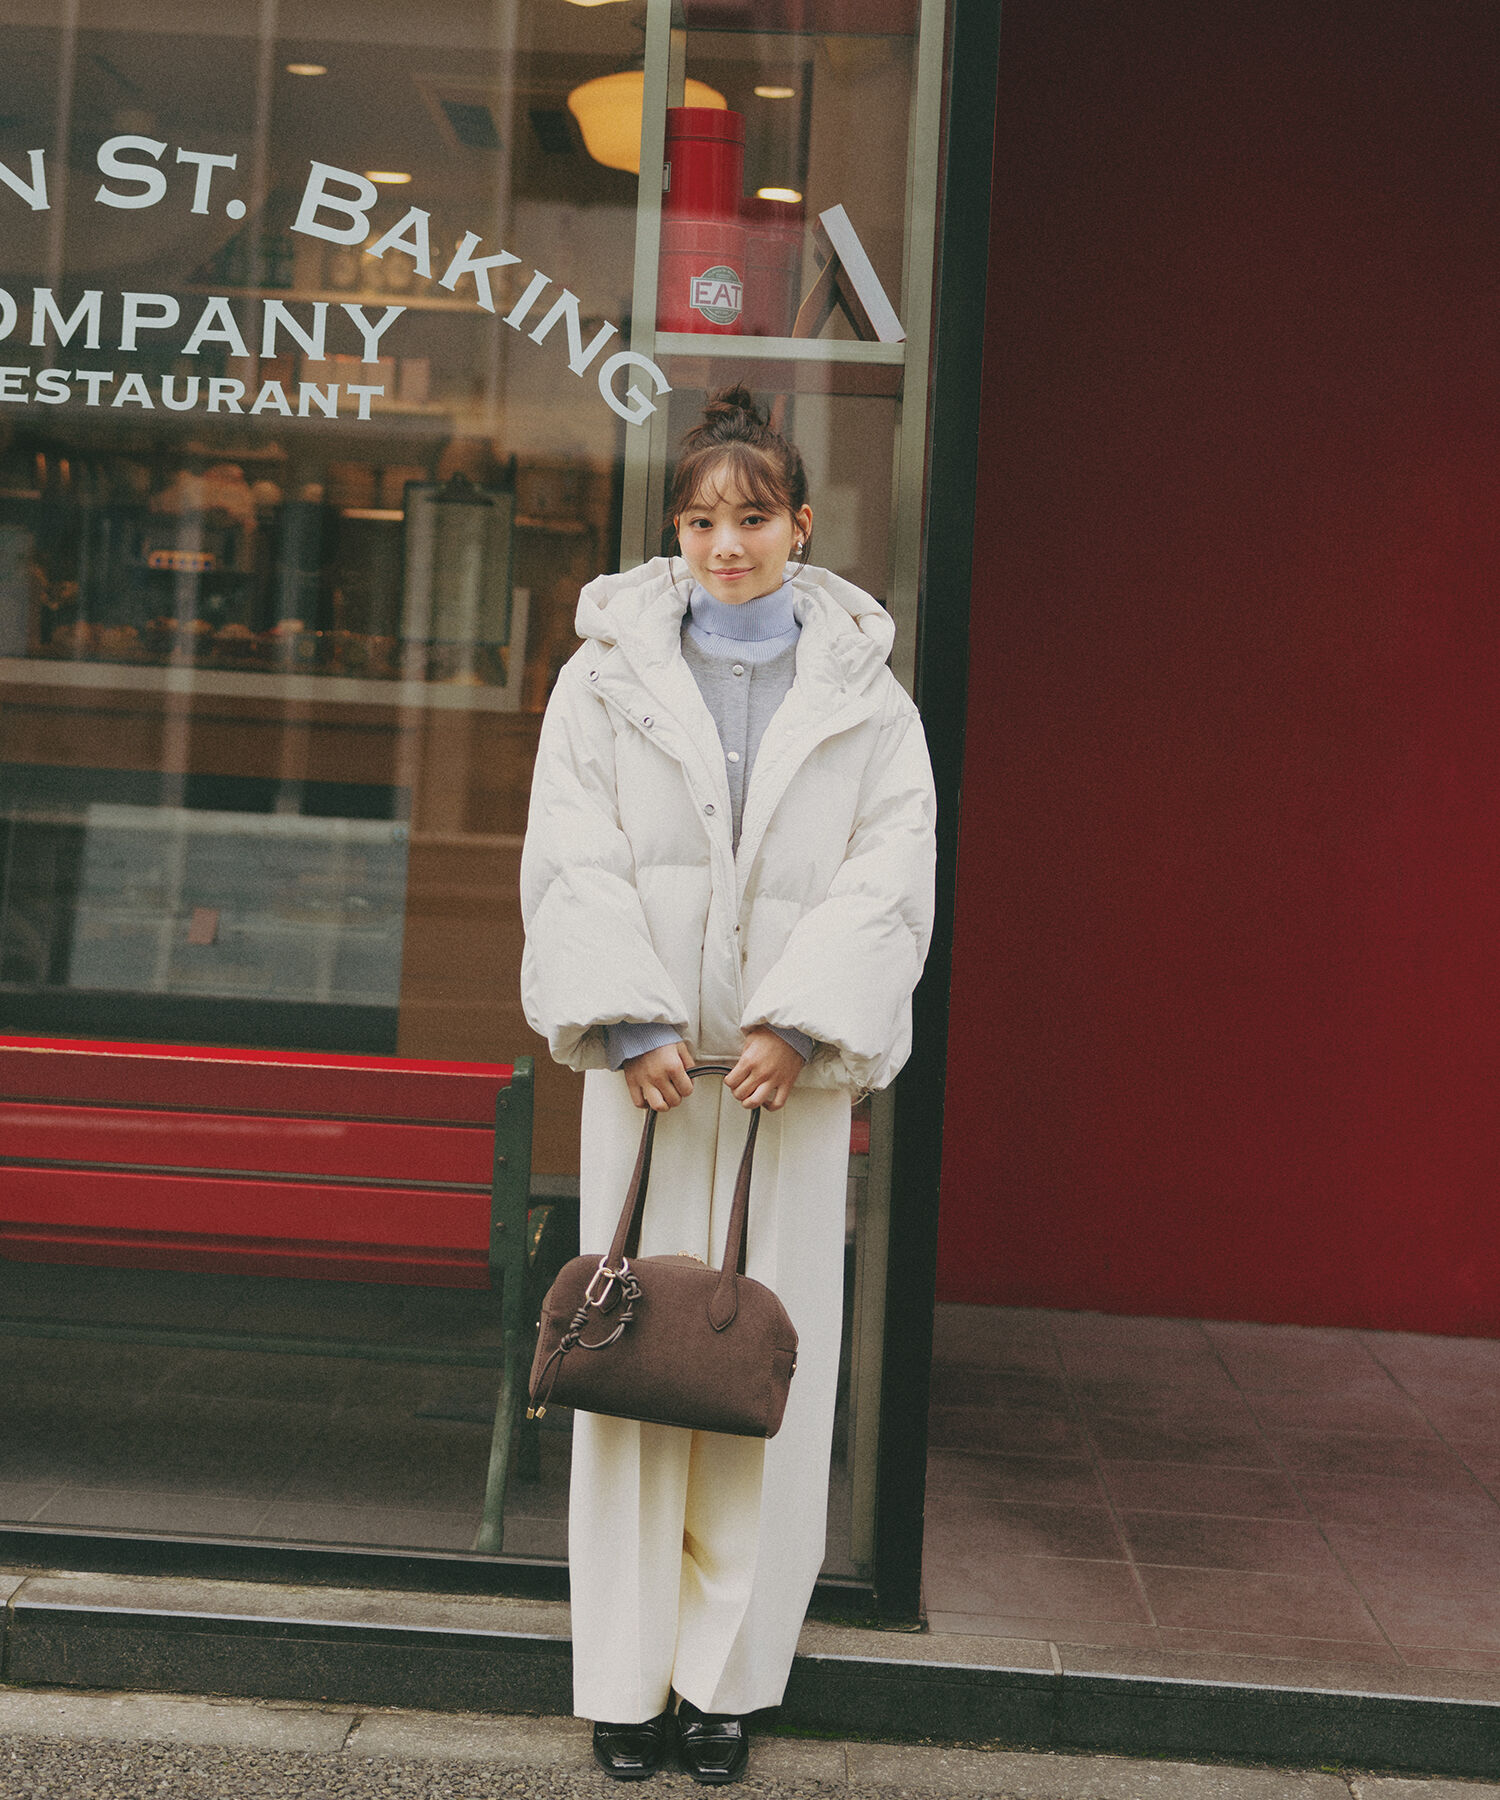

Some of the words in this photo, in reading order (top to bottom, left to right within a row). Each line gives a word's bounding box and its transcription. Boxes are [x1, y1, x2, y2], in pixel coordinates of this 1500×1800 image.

[95, 135, 246, 220] ST.
[290, 160, 672, 426] BAKING
[695, 281, 742, 308] EAT
[0, 287, 407, 364] MPANY
